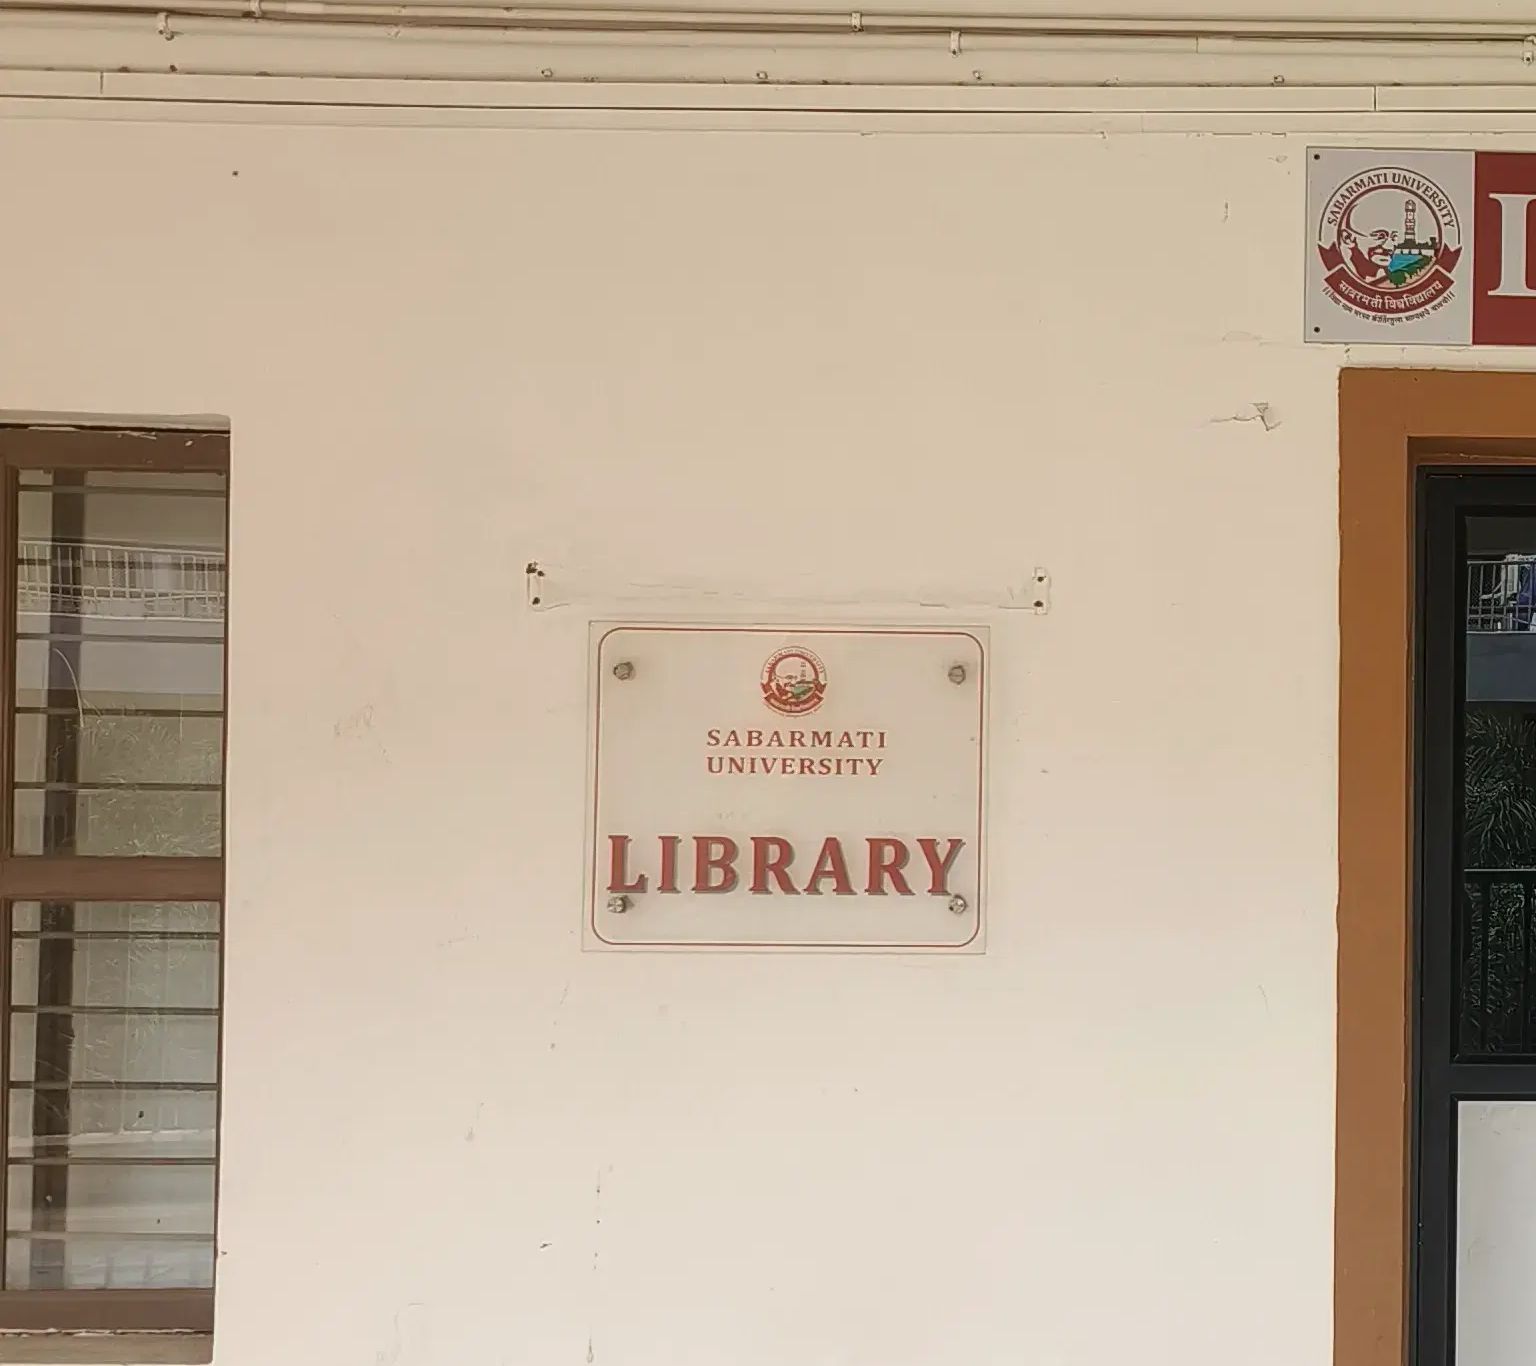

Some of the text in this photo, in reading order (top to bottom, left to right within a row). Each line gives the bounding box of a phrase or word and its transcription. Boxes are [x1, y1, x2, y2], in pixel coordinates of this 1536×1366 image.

[1327, 172, 1456, 228] SABARMATI UNIVERSITY
[707, 729, 888, 748] SABARMATI
[707, 756, 884, 776] UNIVERSITY
[606, 834, 965, 895] LIBRARY
